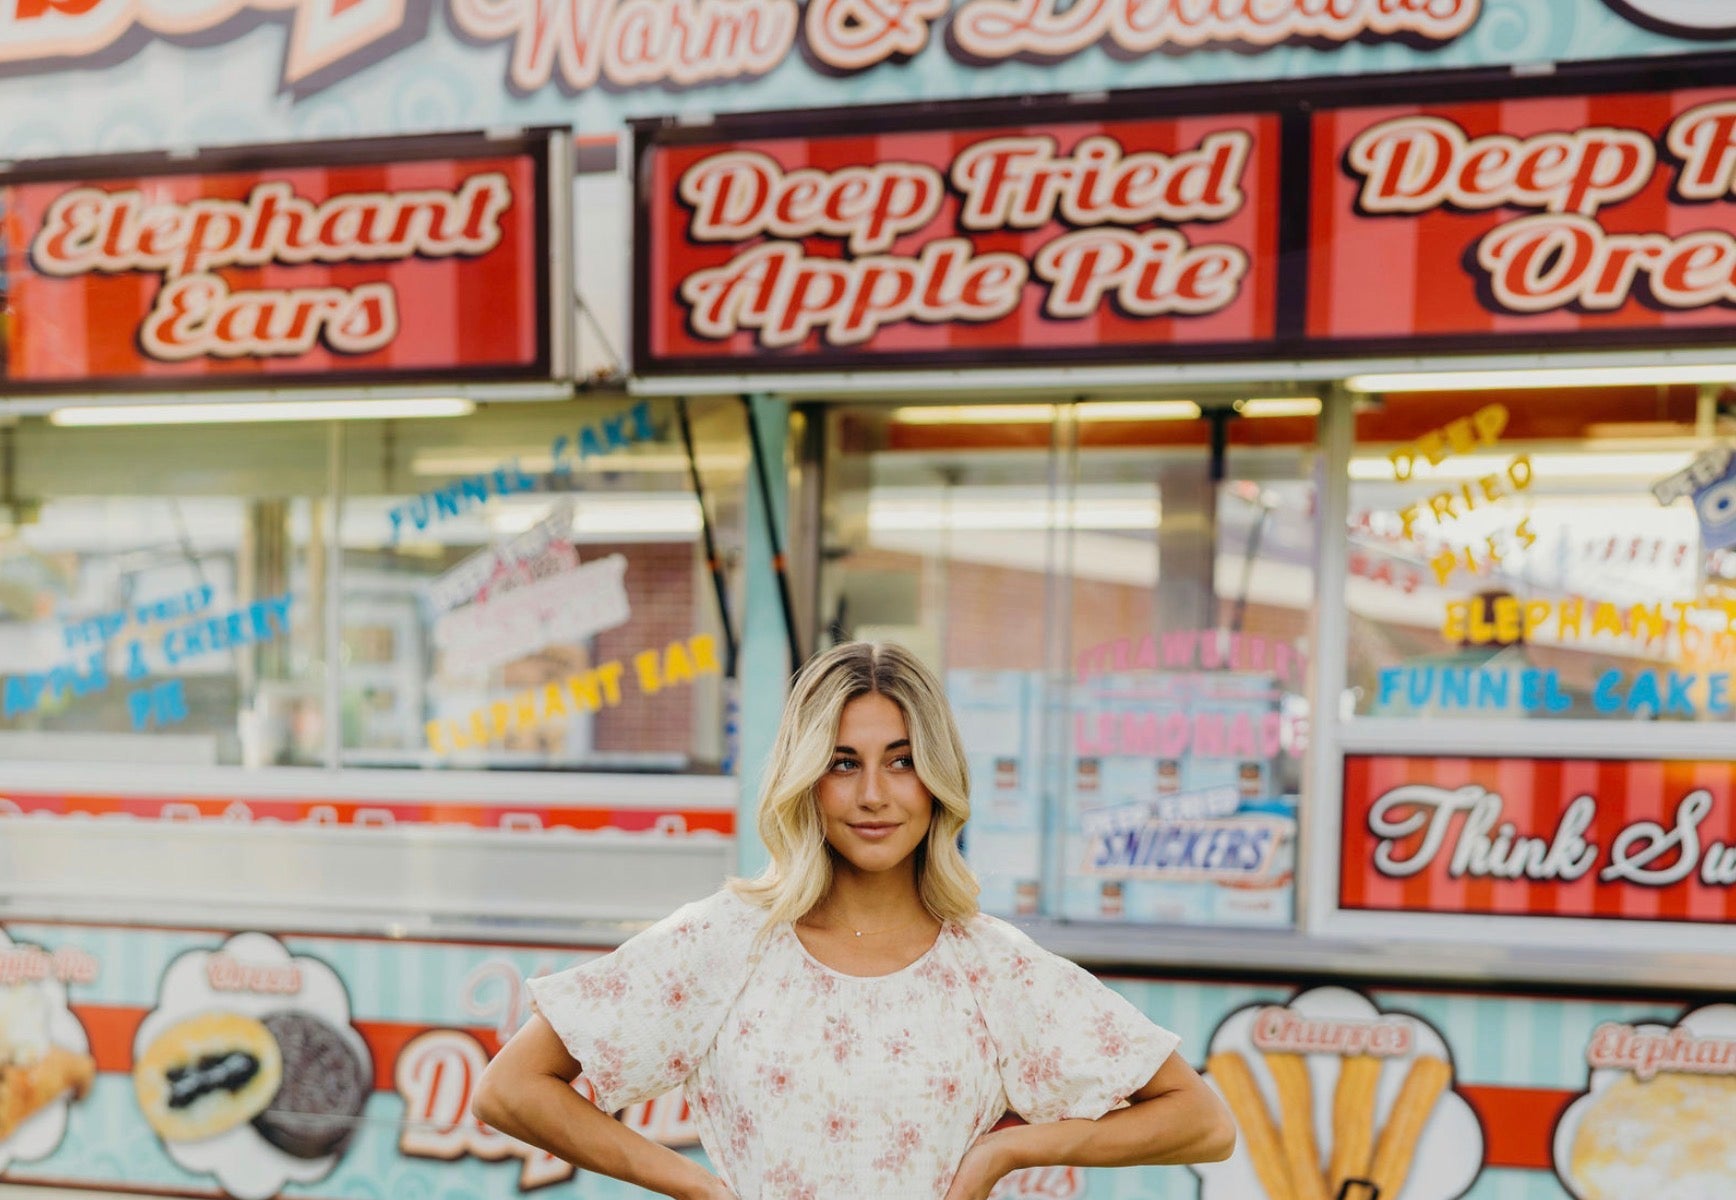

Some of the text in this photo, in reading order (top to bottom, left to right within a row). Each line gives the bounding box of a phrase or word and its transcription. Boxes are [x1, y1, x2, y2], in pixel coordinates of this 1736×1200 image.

[682, 130, 1252, 253] Deep Fried
[1349, 116, 1656, 216] Deep
[33, 173, 512, 277] Elephant
[1478, 214, 1736, 312] Ore
[145, 275, 396, 358] Ears
[683, 229, 1250, 346] Apple Pie
[1397, 454, 1533, 542] FRIED
[1441, 592, 1702, 642] ELEPHANT
[1376, 666, 1731, 714] FUNNEL CAKE
[1093, 826, 1272, 871] SNICKERS
[1368, 784, 1598, 877] Think
